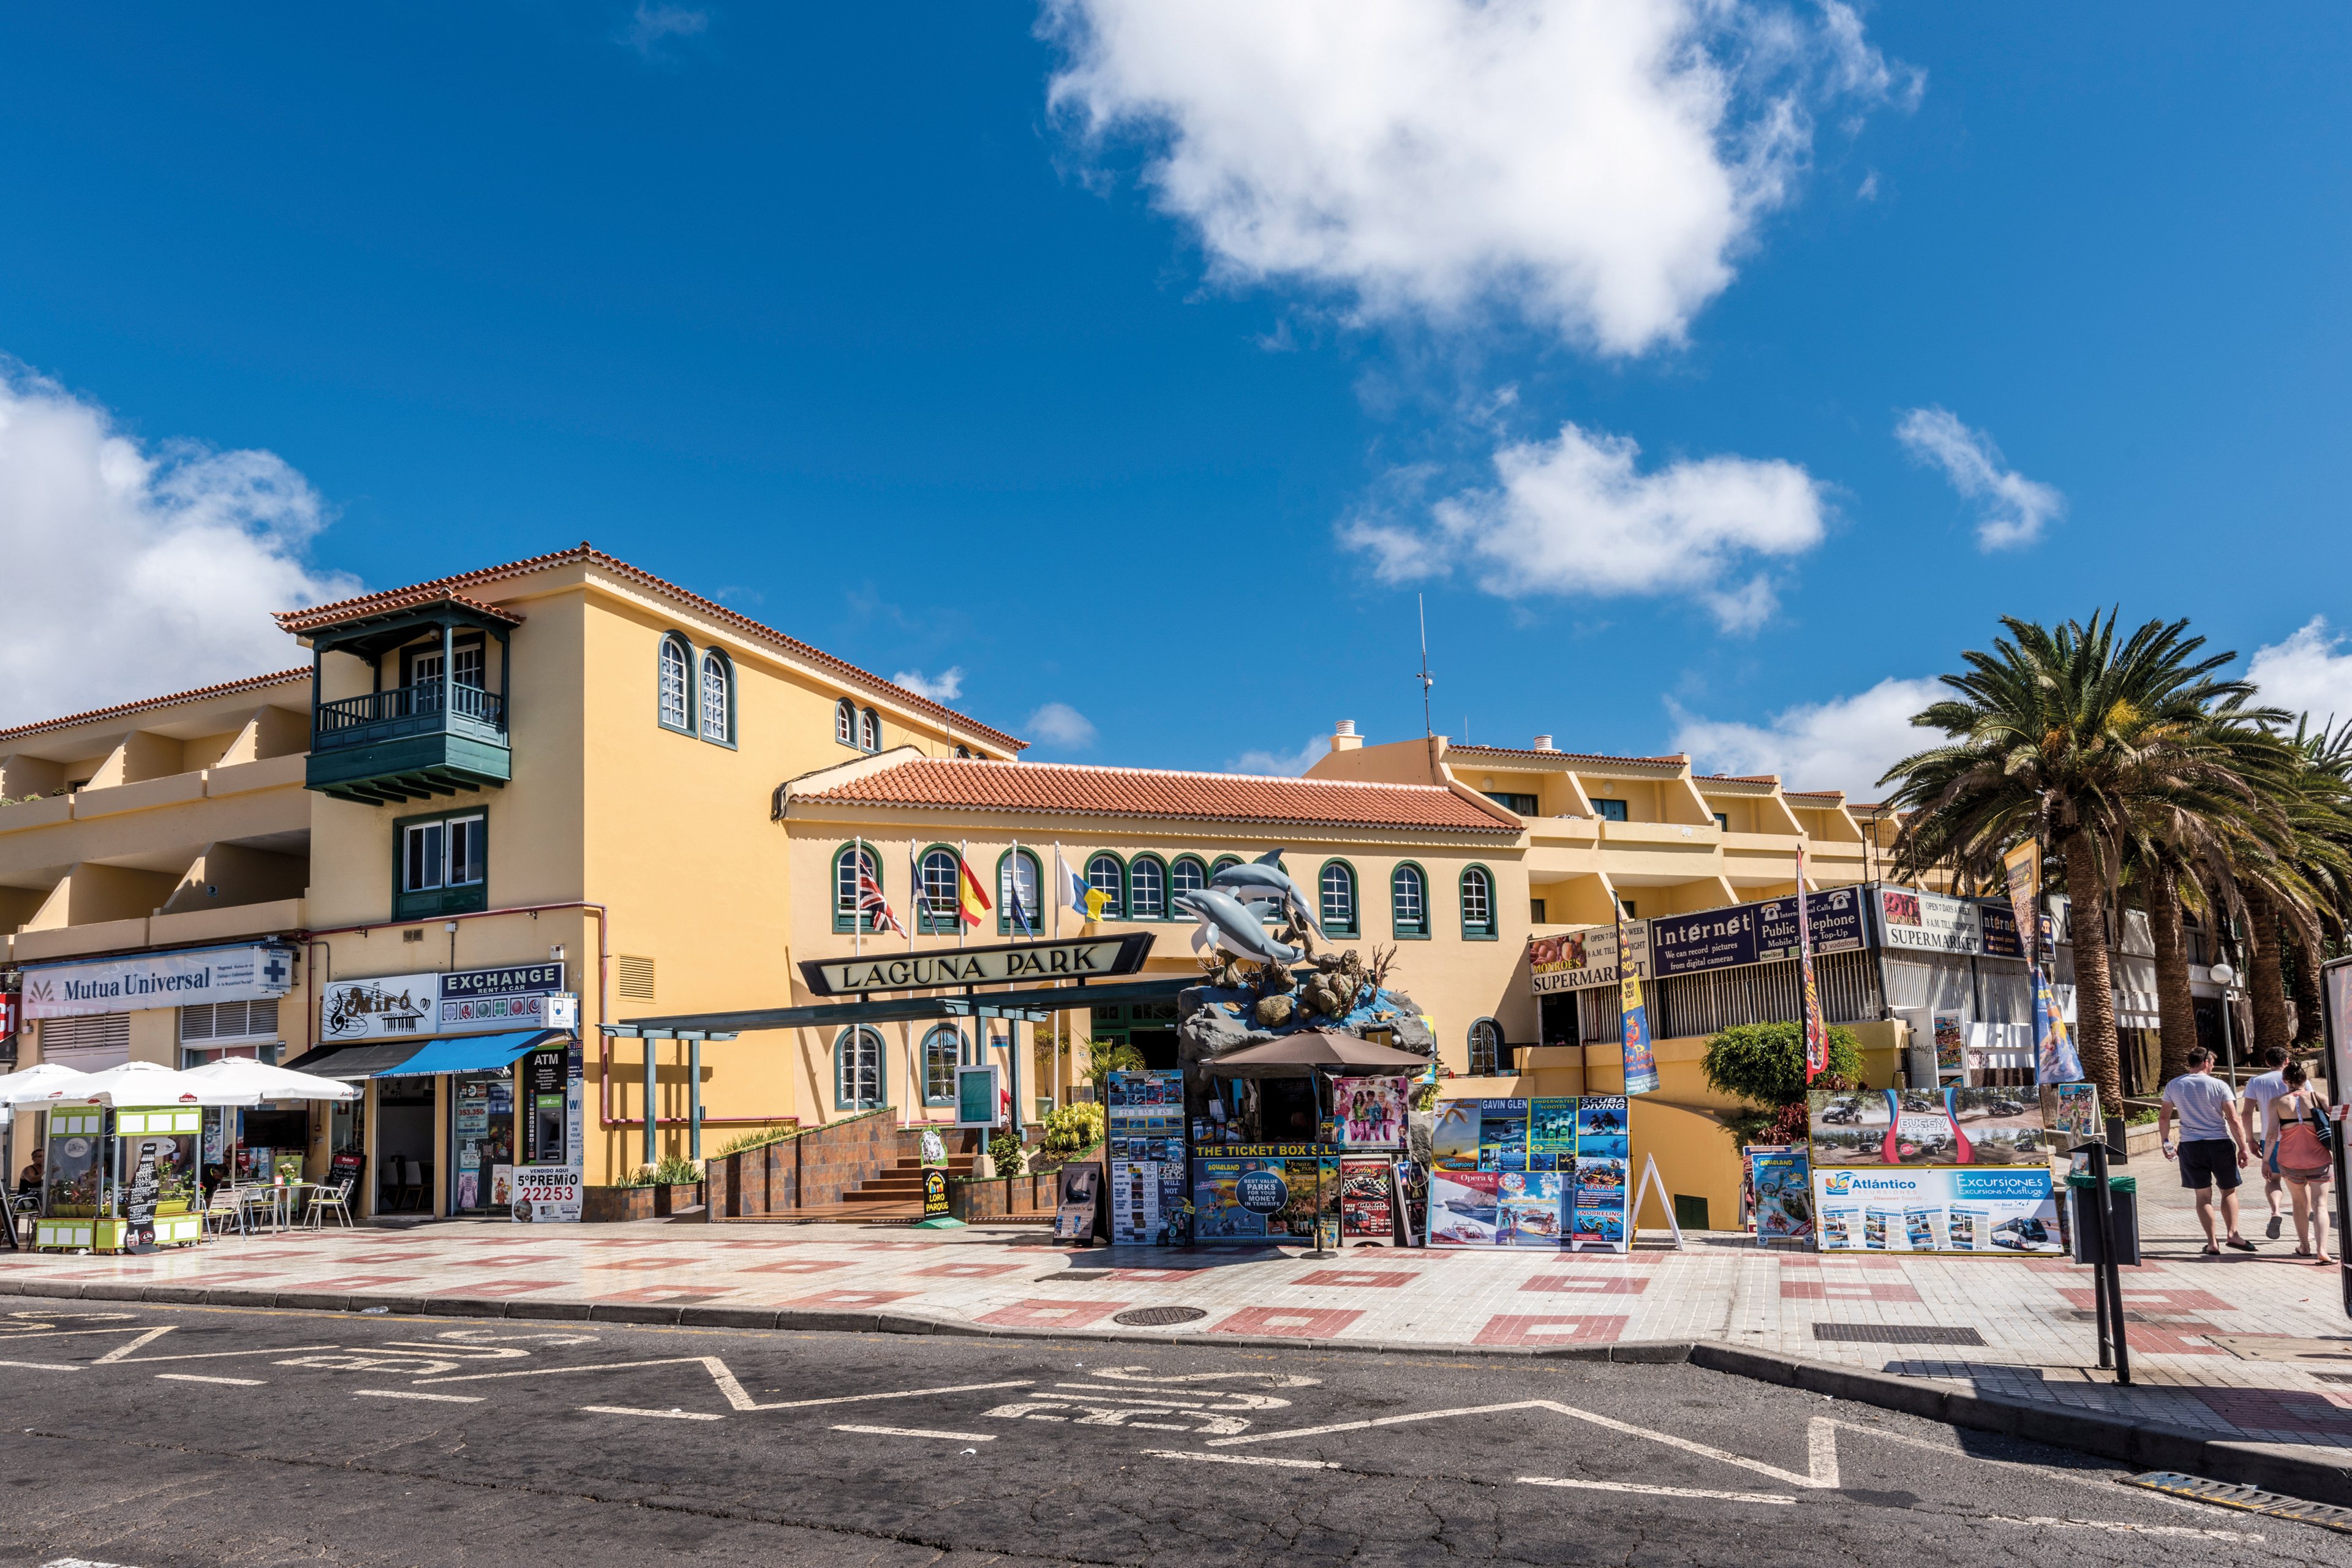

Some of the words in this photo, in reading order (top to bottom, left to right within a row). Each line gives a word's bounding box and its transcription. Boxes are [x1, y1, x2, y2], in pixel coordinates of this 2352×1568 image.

[1816, 904, 1831, 913] Calls
[1926, 902, 1939, 911] OPEN
[1942, 905, 1953, 913] DAYS
[1655, 914, 1751, 946] Internet
[1762, 921, 1796, 938] Public
[1941, 920, 1951, 929] TILL
[1628, 927, 1645, 935] WEEK
[1768, 938, 1793, 948] Mobile
[1795, 935, 1818, 944] Pne
[1819, 929, 1849, 940] Top-Up
[1828, 939, 1859, 949] vodafone
[1891, 929, 1978, 951] SUPERMARKET
[1604, 946, 1616, 956] TILL
[1665, 951, 1675, 959] We
[1688, 944, 1708, 956] record
[1711, 943, 1738, 953] pictures
[843, 956, 987, 989] LAGUNA
[1006, 946, 1098, 976] PARK
[1533, 958, 1581, 974] MONROE'S
[1686, 957, 1706, 968] digital
[1707, 955, 1733, 965] cameras
[447, 968, 555, 990] EXCHANGE
[1534, 961, 1646, 992] SUPERMART
[64, 980, 119, 1001] Mutua
[125, 967, 210, 995] Universal
[344, 987, 411, 1017] Miró
[534, 1054, 558, 1065] ATM
[1482, 1100, 1505, 1109] GAVIN
[1508, 1099, 1527, 1109] GLEN
[1899, 1118, 1947, 1128] BUGGY
[1349, 1119, 1396, 1140] MHT
[1196, 1147, 1223, 1156] THE
[1227, 1145, 1275, 1156] TICKET
[1279, 1145, 1306, 1155] BOX
[1347, 1166, 1378, 1177] Karting
[1461, 1174, 1486, 1183] Opera
[1852, 1179, 1916, 1189] Atlántico
[522, 1186, 573, 1200] 22253
[929, 1193, 945, 1202] LORO
[926, 1202, 949, 1212] PARQUE
[979, 1366, 1323, 1434] BUS
